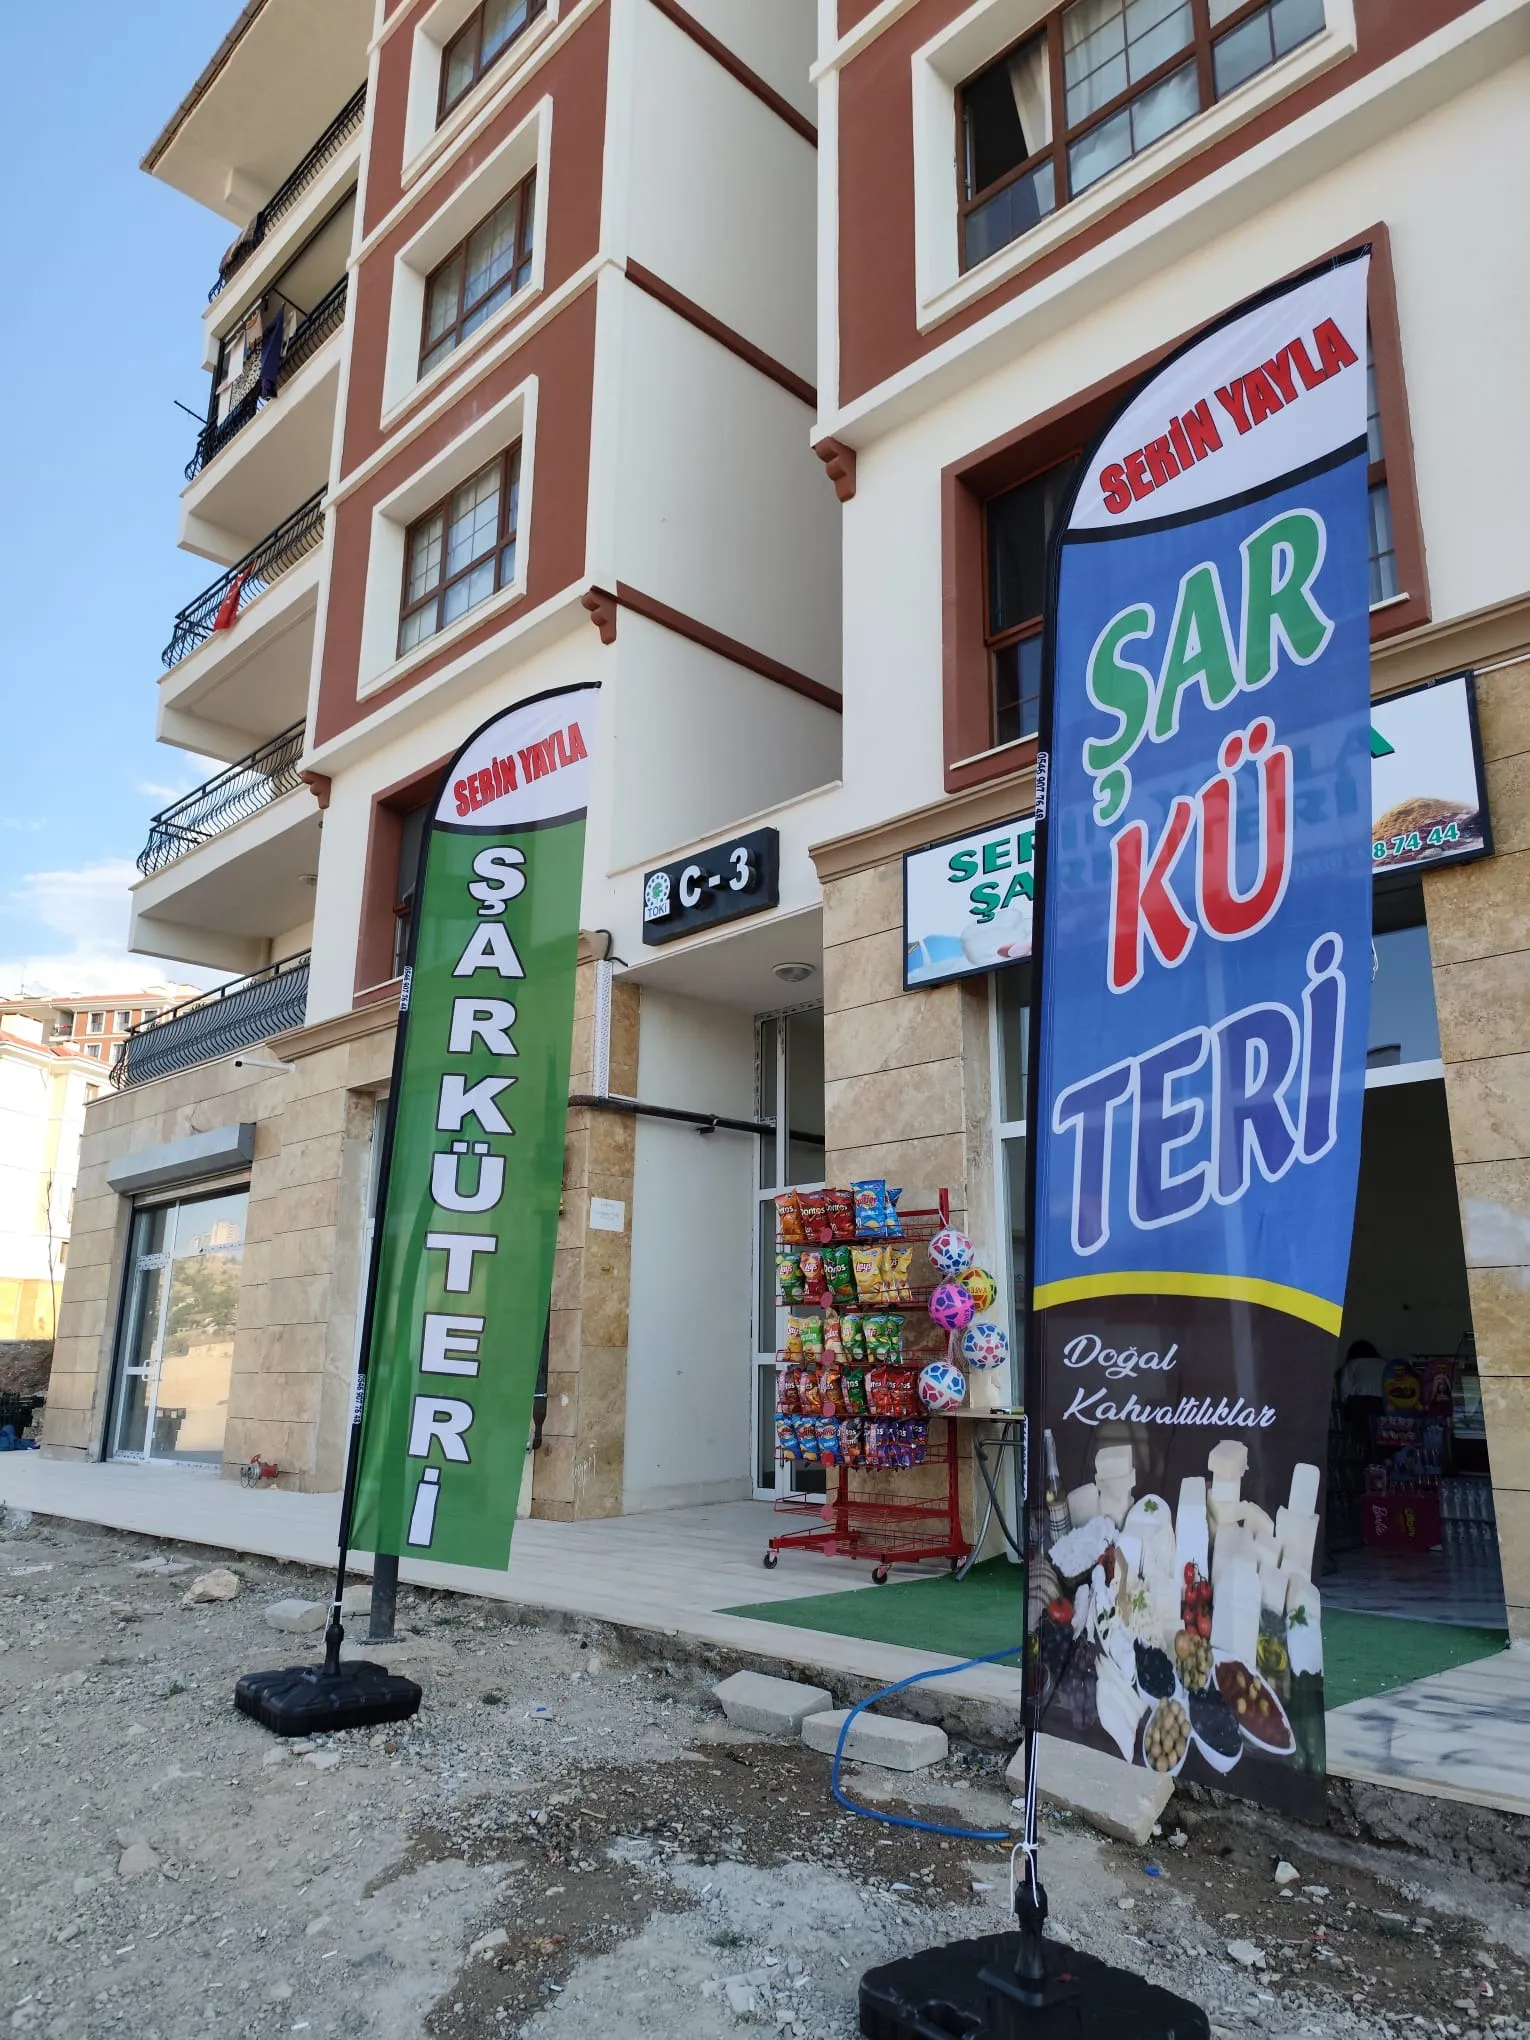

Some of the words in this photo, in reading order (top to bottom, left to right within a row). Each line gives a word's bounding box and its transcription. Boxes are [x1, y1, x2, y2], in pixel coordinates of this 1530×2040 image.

[1213, 317, 1359, 436] YAYLA
[516, 721, 588, 785] YAYLA
[1082, 508, 1335, 827] ŞAR
[1107, 716, 1294, 994] KÜ
[1390, 833, 1421, 855] 74
[1426, 823, 1460, 846] 44
[1052, 931, 1346, 1256] TERİ
[404, 845, 528, 1549] ŞARKÜTERİ
[1063, 1333, 1179, 1380] Doğal
